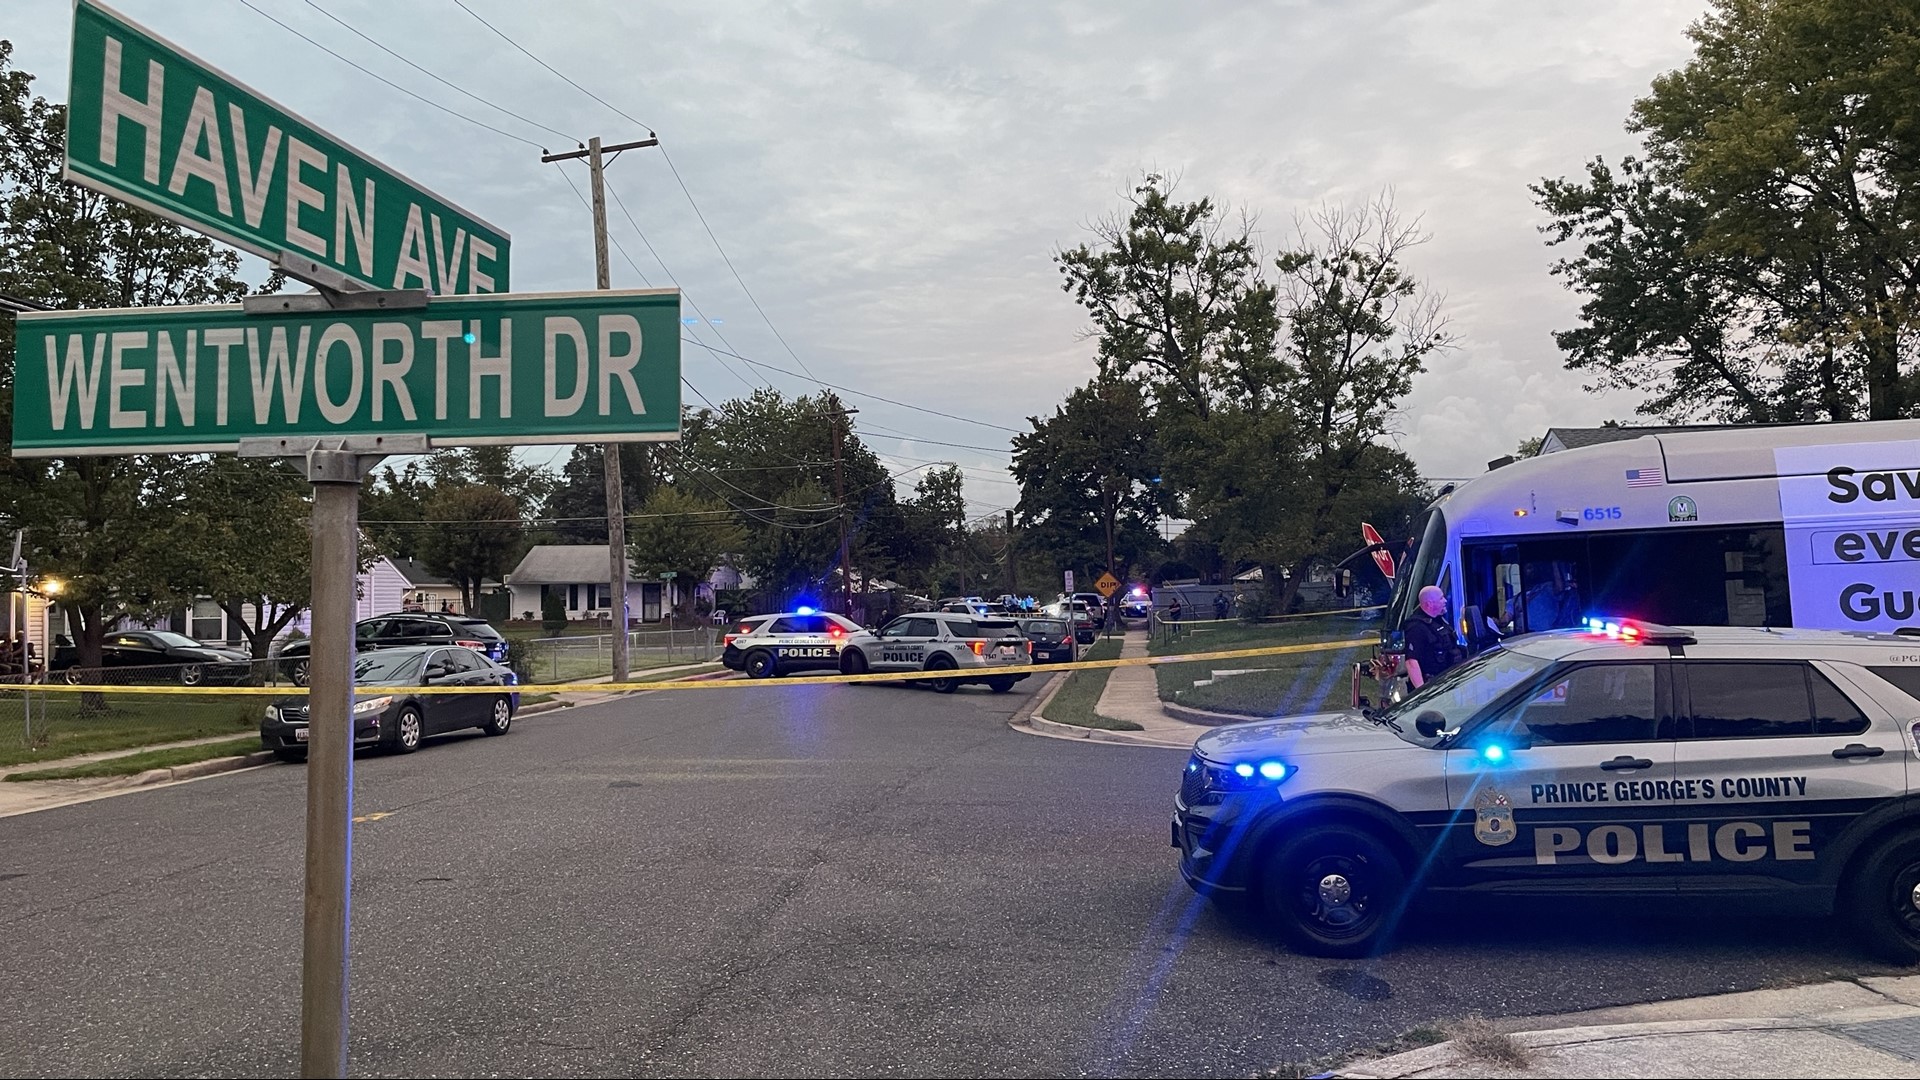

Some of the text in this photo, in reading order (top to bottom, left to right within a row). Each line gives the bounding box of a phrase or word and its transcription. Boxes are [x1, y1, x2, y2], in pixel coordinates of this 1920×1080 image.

[100, 36, 498, 295] HAVEN AVE
[45, 314, 647, 431] WENTWORTH DR
[1584, 507, 1622, 520] 6515
[1839, 583, 1920, 622] Gu
[778, 648, 831, 658] POLICE
[883, 652, 924, 662] POLICE
[1889, 655, 1920, 663] @PG
[1531, 776, 1807, 804] PRINCE GEORGE'S COUNTY
[1534, 821, 1815, 865] POLICE
